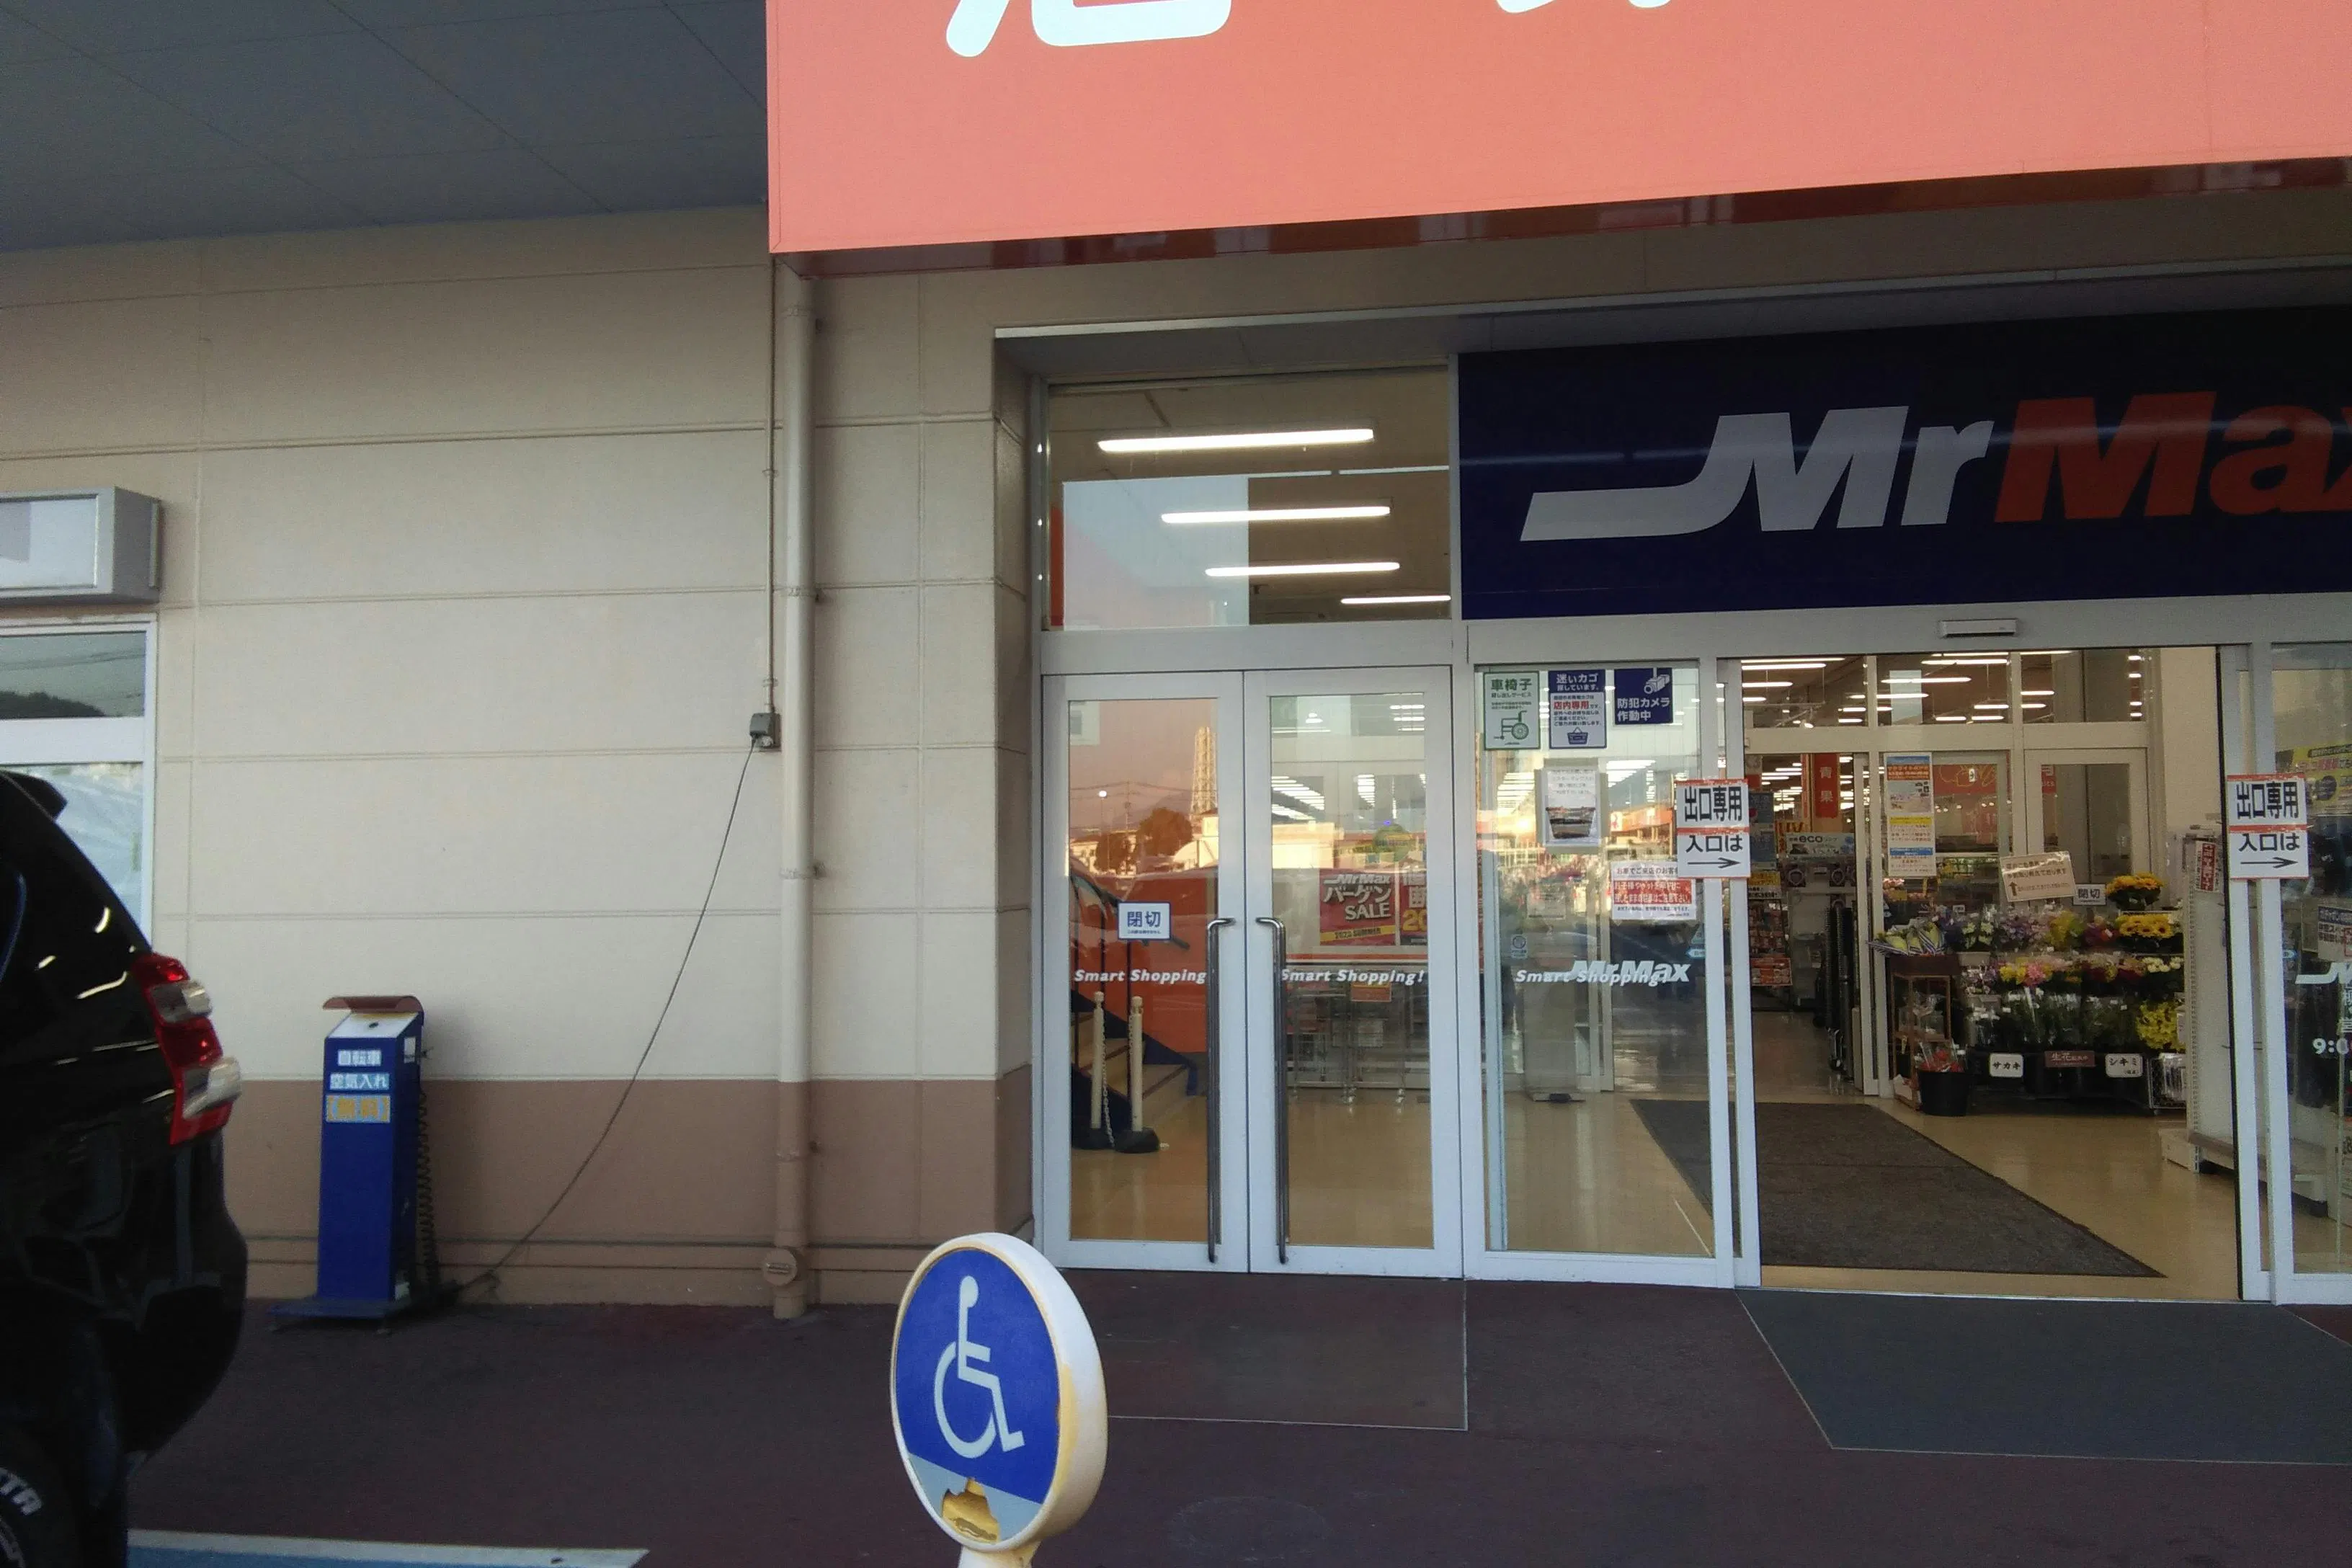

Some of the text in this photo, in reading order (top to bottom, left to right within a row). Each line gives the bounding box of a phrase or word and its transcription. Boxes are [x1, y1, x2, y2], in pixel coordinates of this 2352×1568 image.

[1520, 391, 2352, 541] MrMa
[1491, 678, 1532, 692] 車椅子
[1556, 673, 1598, 684] 迷いカゴ
[1554, 700, 1590, 710] 店内専用
[1617, 697, 1670, 708] 防犯カメラ
[1617, 710, 1652, 721] 作動中
[1685, 786, 1742, 821] 出口専用
[2236, 781, 2299, 820] 出口専用
[1685, 835, 1743, 853] 入口は
[2238, 832, 2299, 852] 入口は
[1323, 873, 1391, 884] MrMax
[1322, 885, 1391, 904] バーゲン
[1345, 902, 1391, 920] SALE
[1127, 911, 1161, 927] 閉切
[1074, 969, 1124, 982] Smart
[1280, 968, 1425, 985] Smart Shopping!
[1515, 970, 1572, 983] Smart
[1992, 1061, 2021, 1070] サカキ
[2109, 1057, 2138, 1066] シキミ
[330, 1072, 389, 1090] 空気入れ
